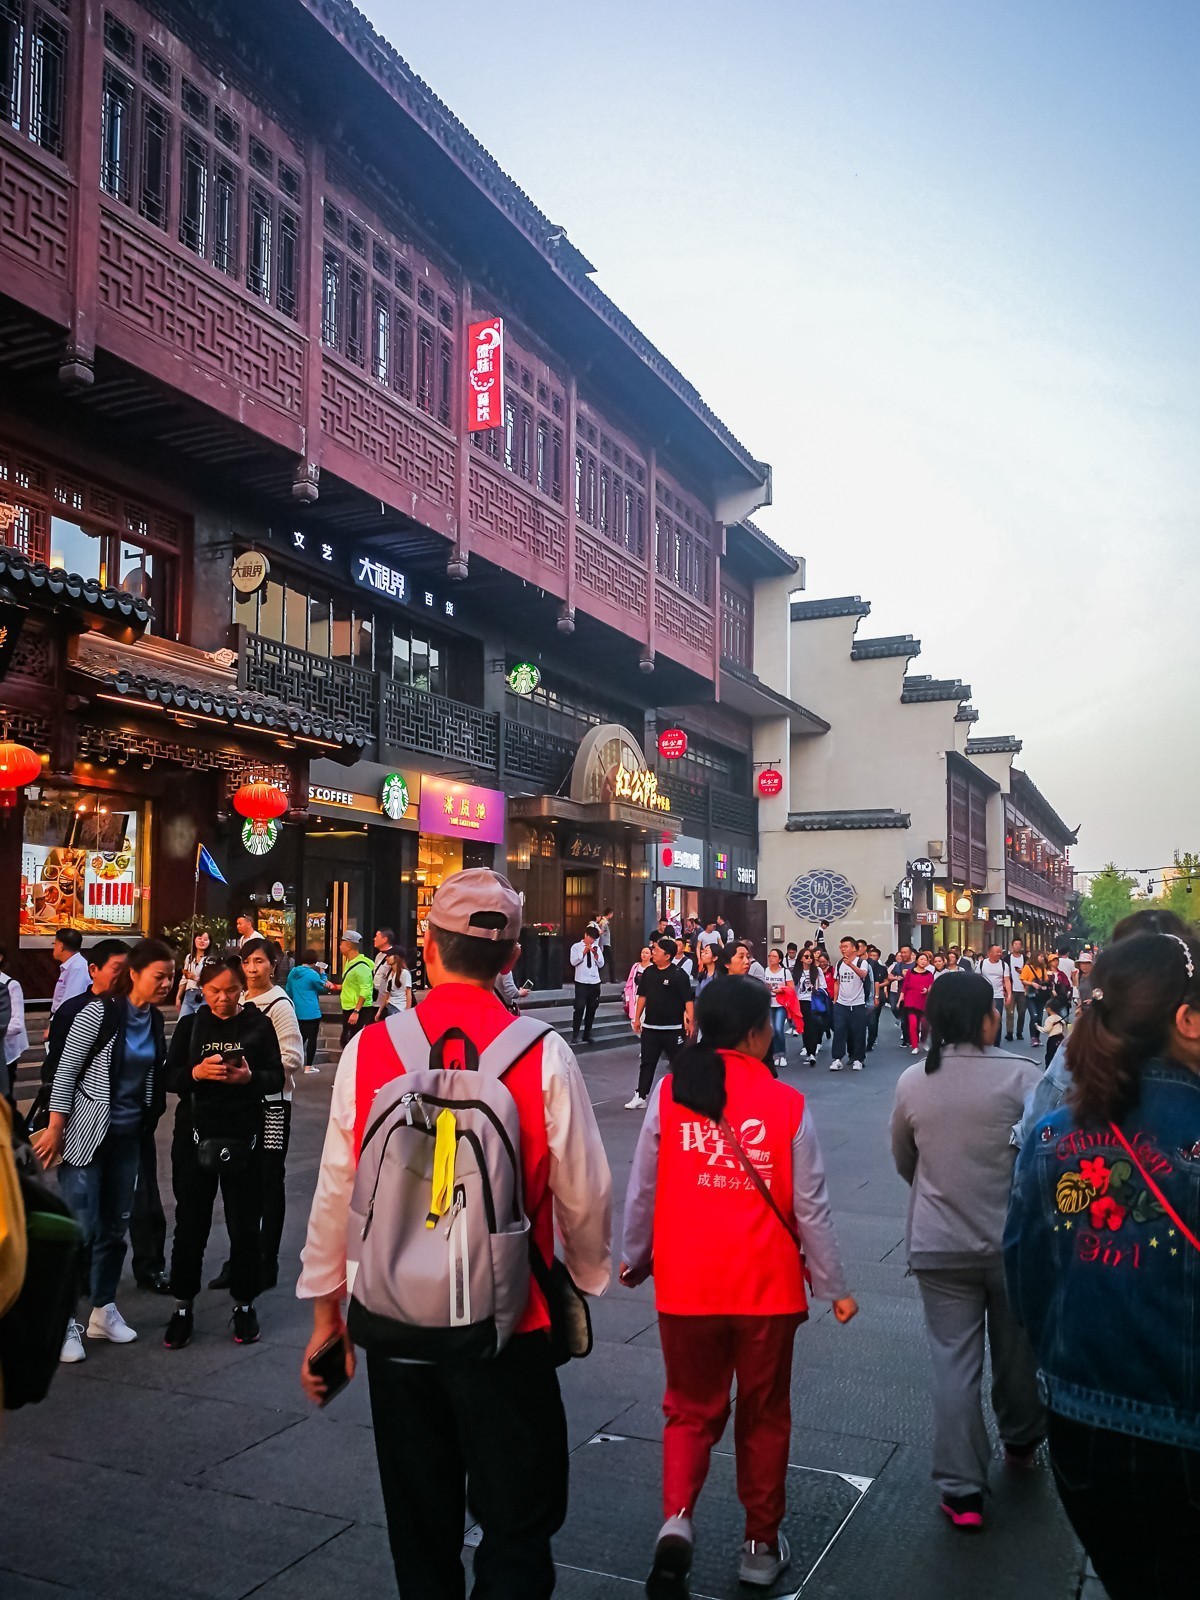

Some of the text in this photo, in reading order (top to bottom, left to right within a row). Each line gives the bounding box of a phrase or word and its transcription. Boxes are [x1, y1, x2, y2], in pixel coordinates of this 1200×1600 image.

[293, 531, 333, 561] 文艺
[424, 591, 454, 617] 百货
[316, 788, 354, 805] COFFEE
